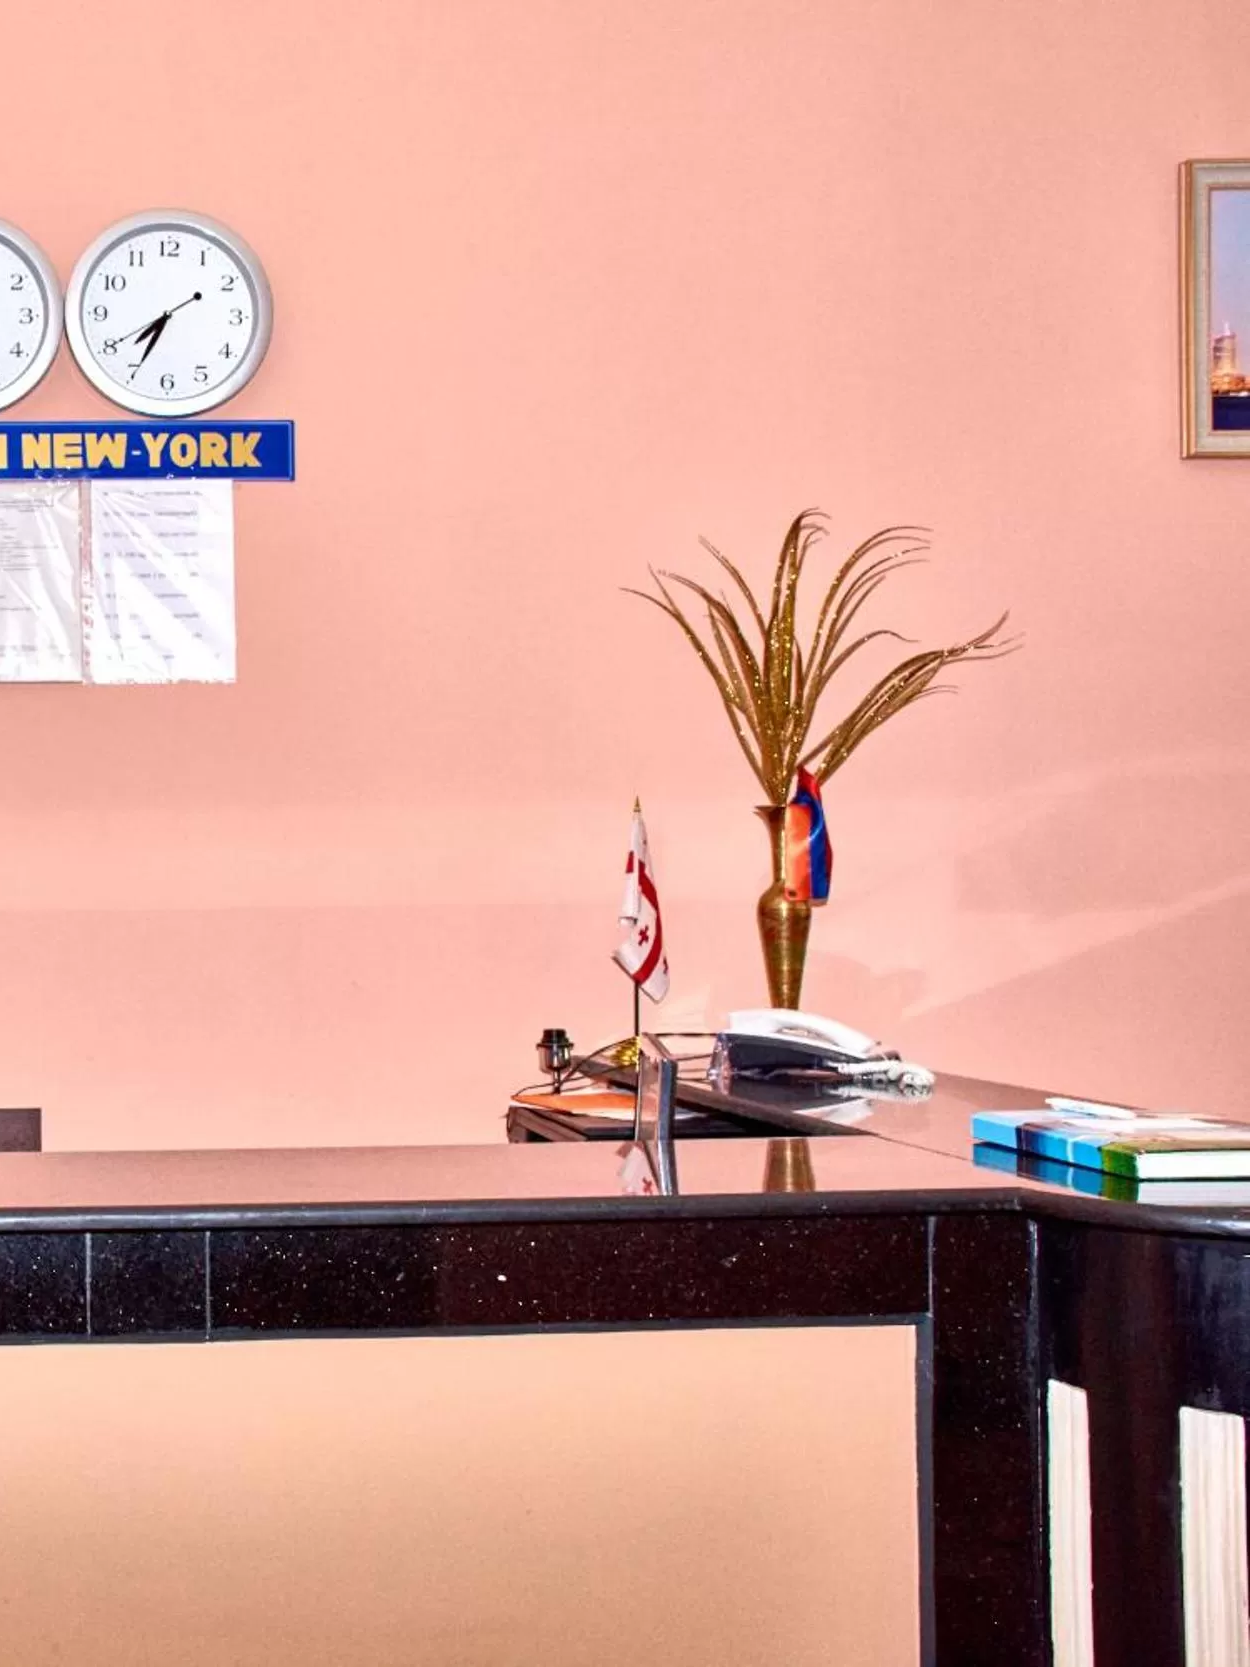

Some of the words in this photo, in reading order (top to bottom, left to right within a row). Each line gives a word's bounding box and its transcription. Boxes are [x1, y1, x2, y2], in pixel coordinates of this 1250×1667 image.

[159, 240, 180, 258] 12
[129, 250, 144, 267] 11
[199, 251, 207, 266] 1
[10, 274, 24, 291] 2
[104, 274, 127, 291] 10
[221, 275, 235, 292] 2
[19, 307, 34, 324] 3
[93, 305, 108, 321] 9
[229, 309, 243, 325] 3
[9, 341, 24, 358] 4
[102, 338, 118, 355] 8
[218, 342, 232, 359] 4
[126, 364, 142, 383] 7
[159, 374, 175, 390] 6
[193, 365, 208, 382] 5
[22, 432, 262, 468] NEW-YORK
